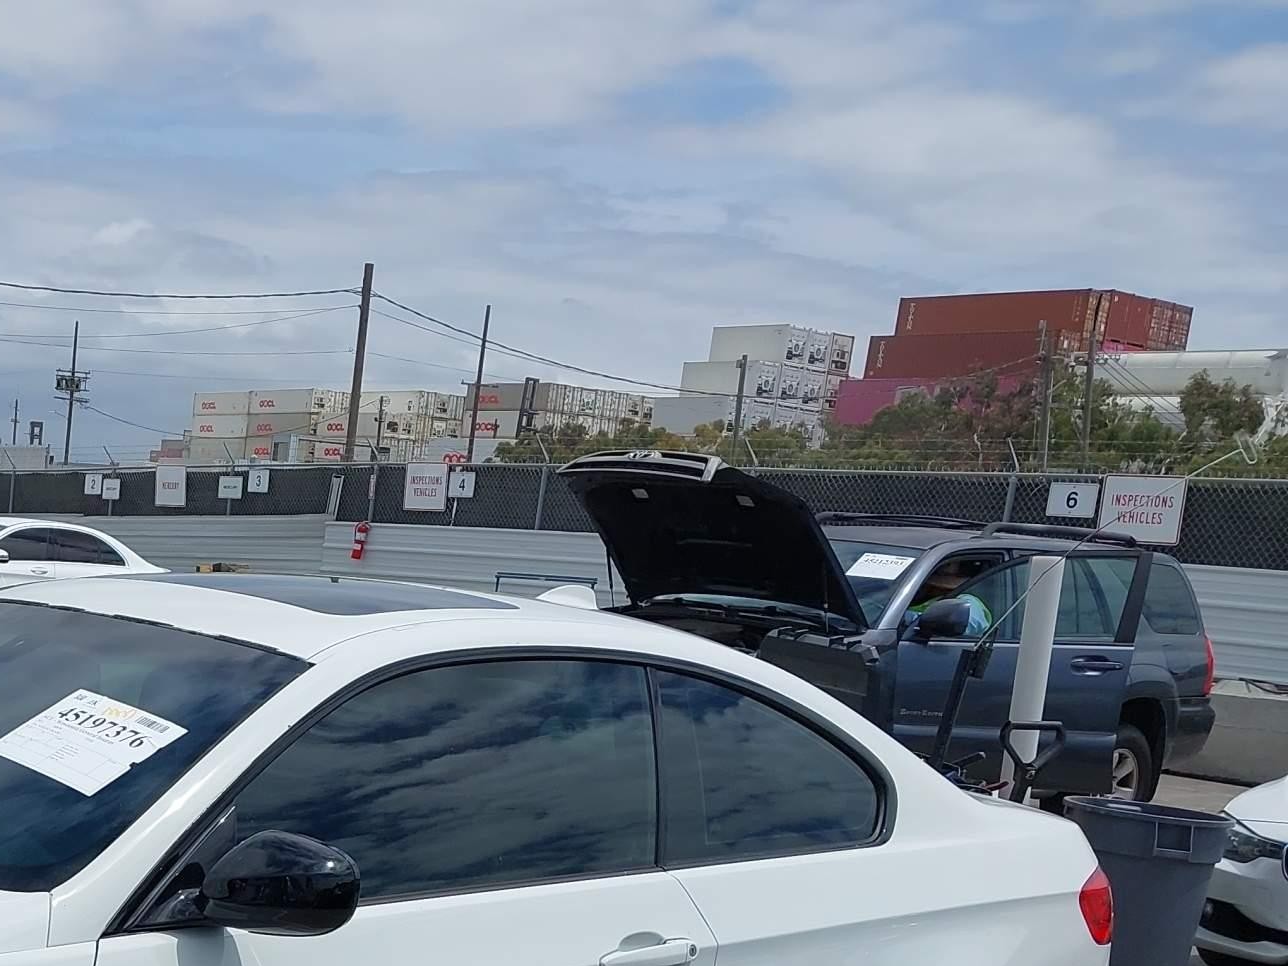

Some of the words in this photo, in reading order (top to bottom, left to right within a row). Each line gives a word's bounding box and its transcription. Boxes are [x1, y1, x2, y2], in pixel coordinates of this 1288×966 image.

[259, 399, 275, 408] OOCL
[200, 424, 214, 433] OOCL
[257, 423, 272, 432] OOCL
[327, 423, 344, 432] OOCL
[254, 447, 270, 455] OOCL
[324, 448, 341, 456] OOCL
[90, 479, 96, 490] 2
[255, 473, 262, 487] 3
[410, 476, 443, 486] INSPECTIONS
[458, 478, 466, 491] 4
[1066, 491, 1078, 509] 6
[1111, 494, 1175, 509] INSPECTIONS
[1118, 511, 1164, 525] VEHICLES
[57, 706, 153, 749] 45197376
